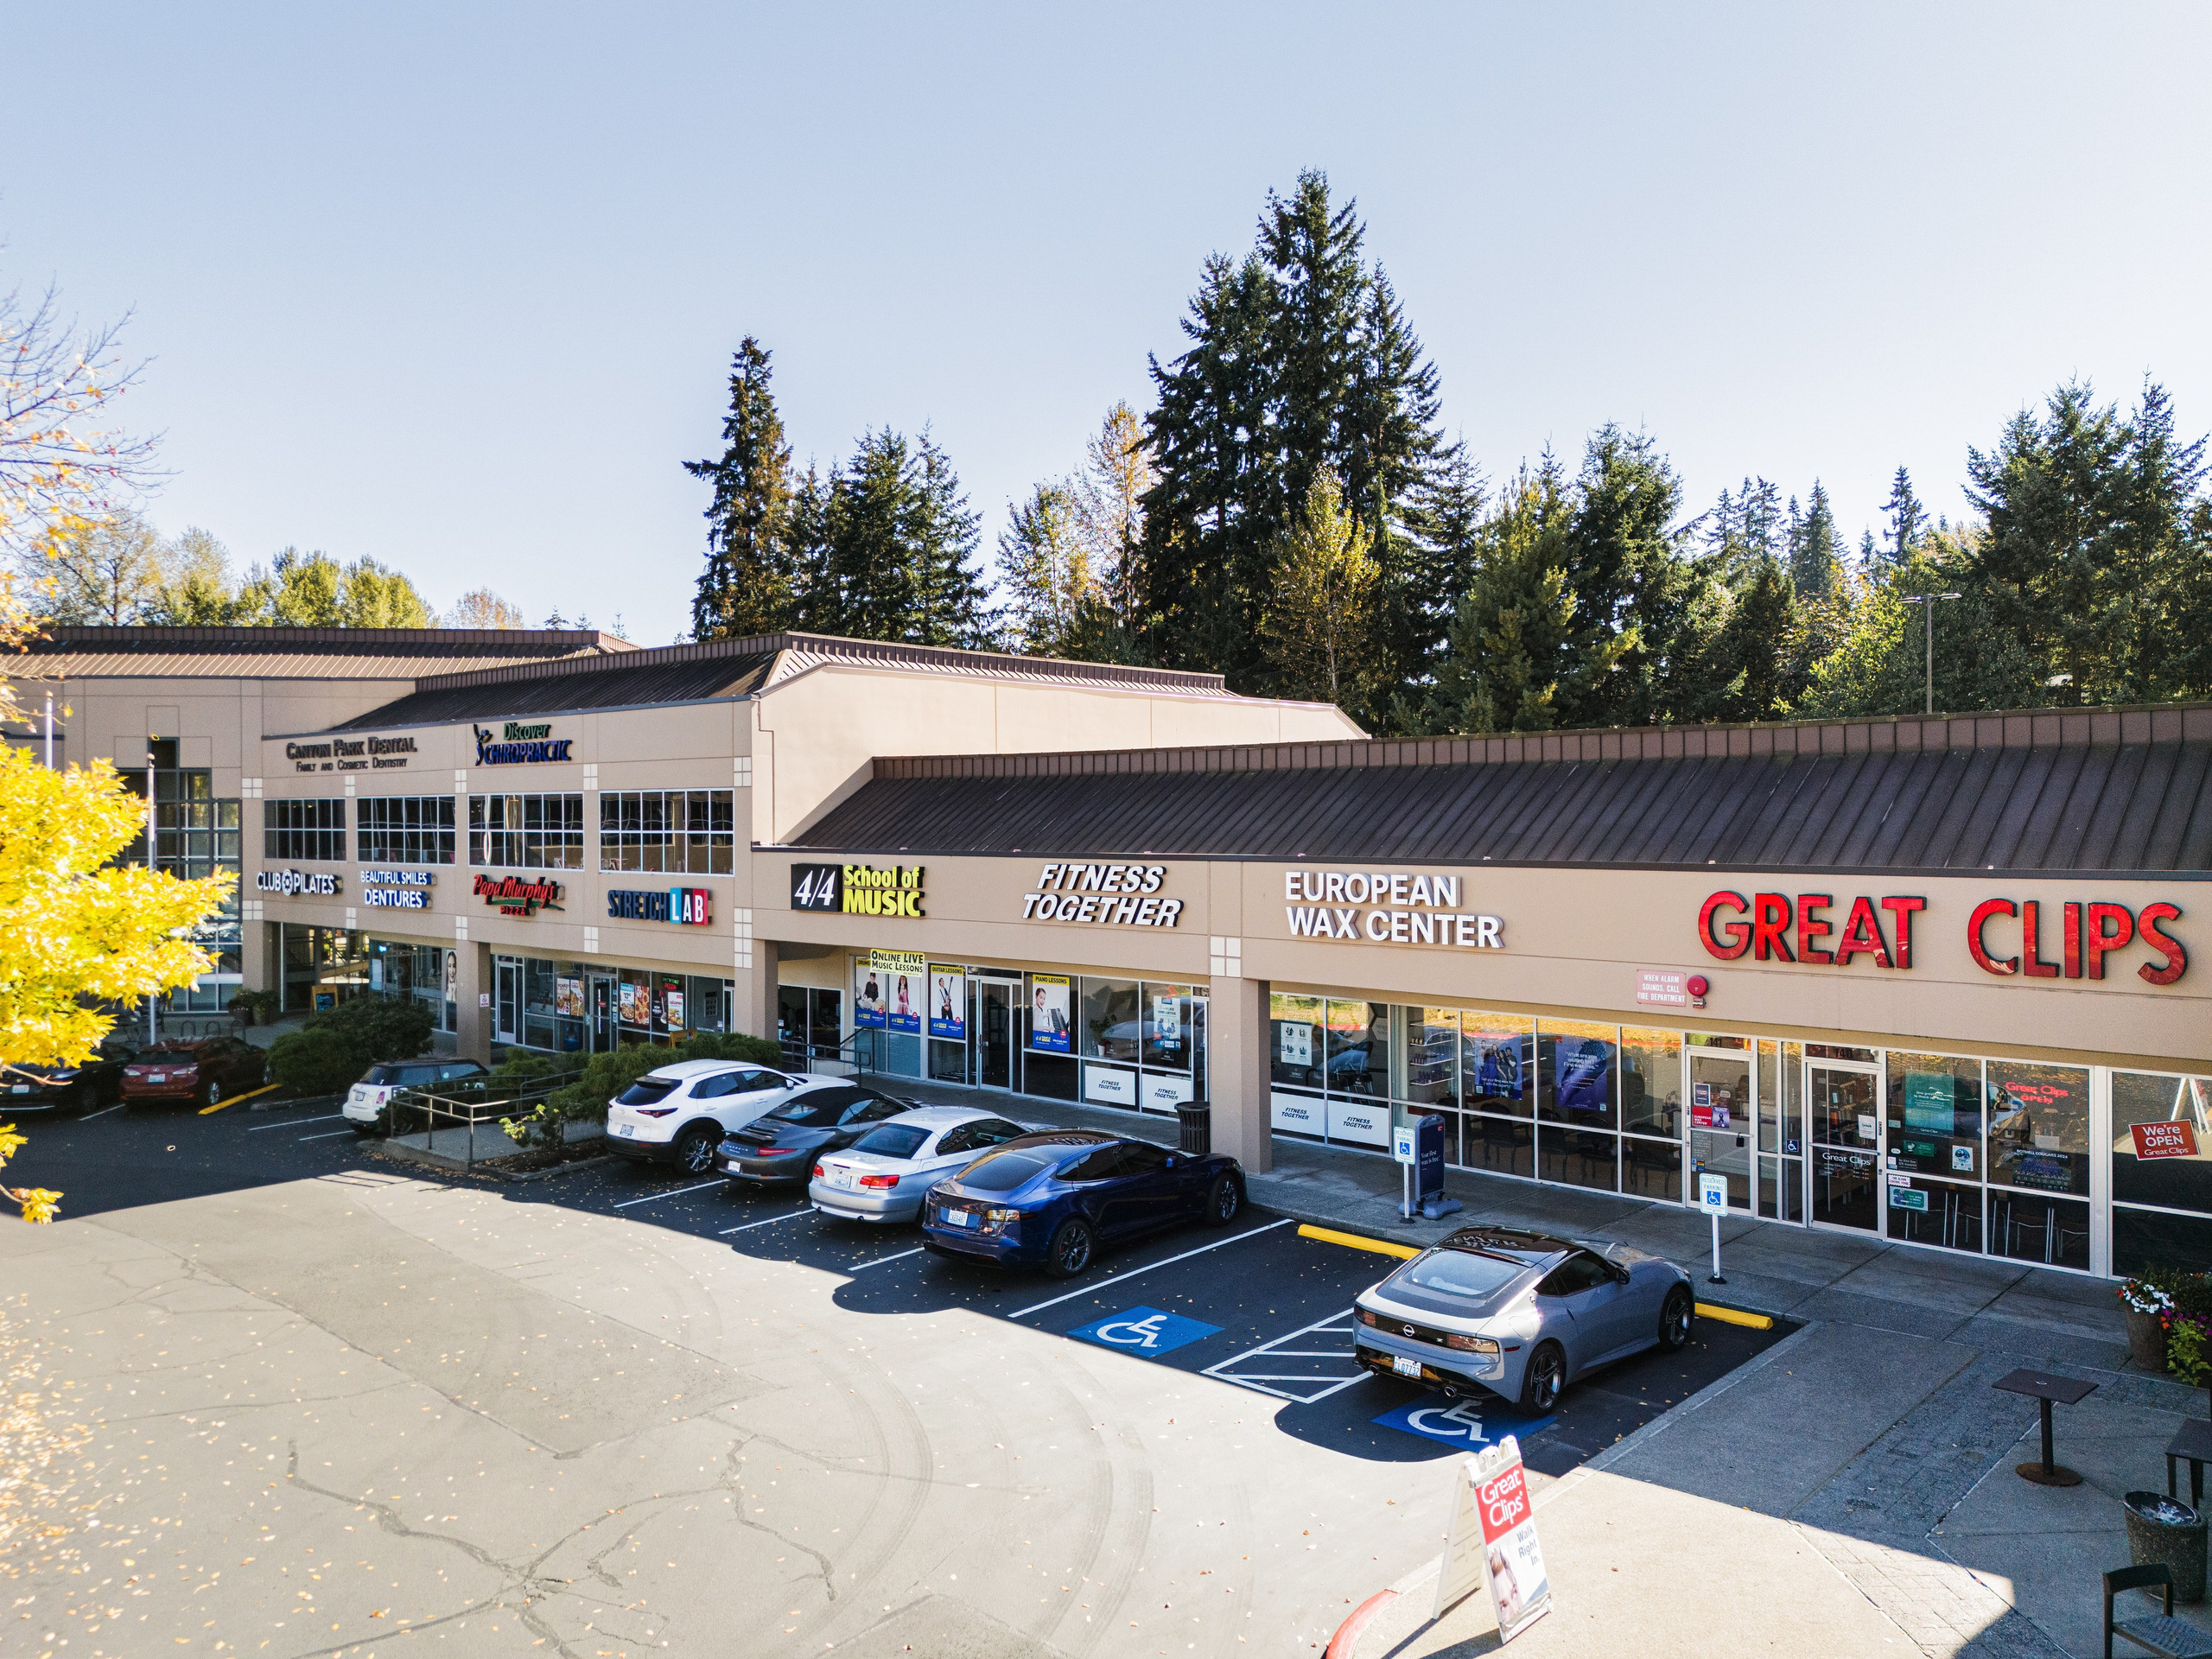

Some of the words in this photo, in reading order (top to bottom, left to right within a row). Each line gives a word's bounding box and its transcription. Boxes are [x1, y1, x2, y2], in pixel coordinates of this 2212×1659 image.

[503, 721, 551, 741] Discover
[286, 742, 331, 760] CANYON
[334, 739, 365, 757] PARK
[367, 736, 417, 754] DENTAL
[484, 740, 573, 765] CHIROPRACTIC
[321, 762, 334, 771] AND
[257, 871, 282, 891] CLUB
[294, 874, 335, 895] PILATES
[360, 869, 401, 885] BEAUTIFUL
[401, 871, 429, 886] SMILES
[843, 864, 899, 888] School
[901, 866, 921, 889] of
[1036, 864, 1166, 894] FITNESS
[473, 874, 502, 906] Papa
[501, 875, 556, 909] Murphy's
[794, 868, 836, 907] 4/4
[1285, 871, 1460, 907] EUROPEAN
[365, 888, 423, 909] DENTURES
[842, 888, 922, 918] MUSIC
[499, 906, 527, 916] PIZZA
[1021, 893, 1183, 928] TOGETHER
[1285, 907, 1360, 939] WAX
[1365, 910, 1505, 949] CENTER
[1698, 890, 1927, 969] GREAT
[1967, 899, 2189, 986] CLIPS
[871, 950, 901, 962] ONLINE
[904, 953, 924, 964] LIVE
[871, 961, 893, 969] MUSIC
[895, 963, 923, 973] LESSONS
[1643, 974, 1659, 982] WHEN
[1650, 993, 1685, 1002] DEPARTMENT
[2005, 1082, 2038, 1094] Great
[2040, 1085, 2069, 1098] Clips
[2020, 1094, 2054, 1104] OPEN
[1281, 1111, 1310, 1120] TOGETHER
[1343, 1121, 1373, 1130] TOGETHER
[2142, 1124, 2181, 1136] We're
[2145, 1135, 2184, 1147] OPEN
[2168, 1147, 2189, 1155] Clips
[1822, 1152, 1848, 1162] Great
[1849, 1156, 1872, 1166] Clips
[1701, 1176, 1725, 1185] RESERVED
[1481, 1468, 1522, 1505] Great
[1489, 1495, 1523, 1528] Clips
[1516, 1523, 1535, 1543] Walk
[1517, 1538, 1538, 1560] Right
[1530, 1555, 1541, 1567] In.
